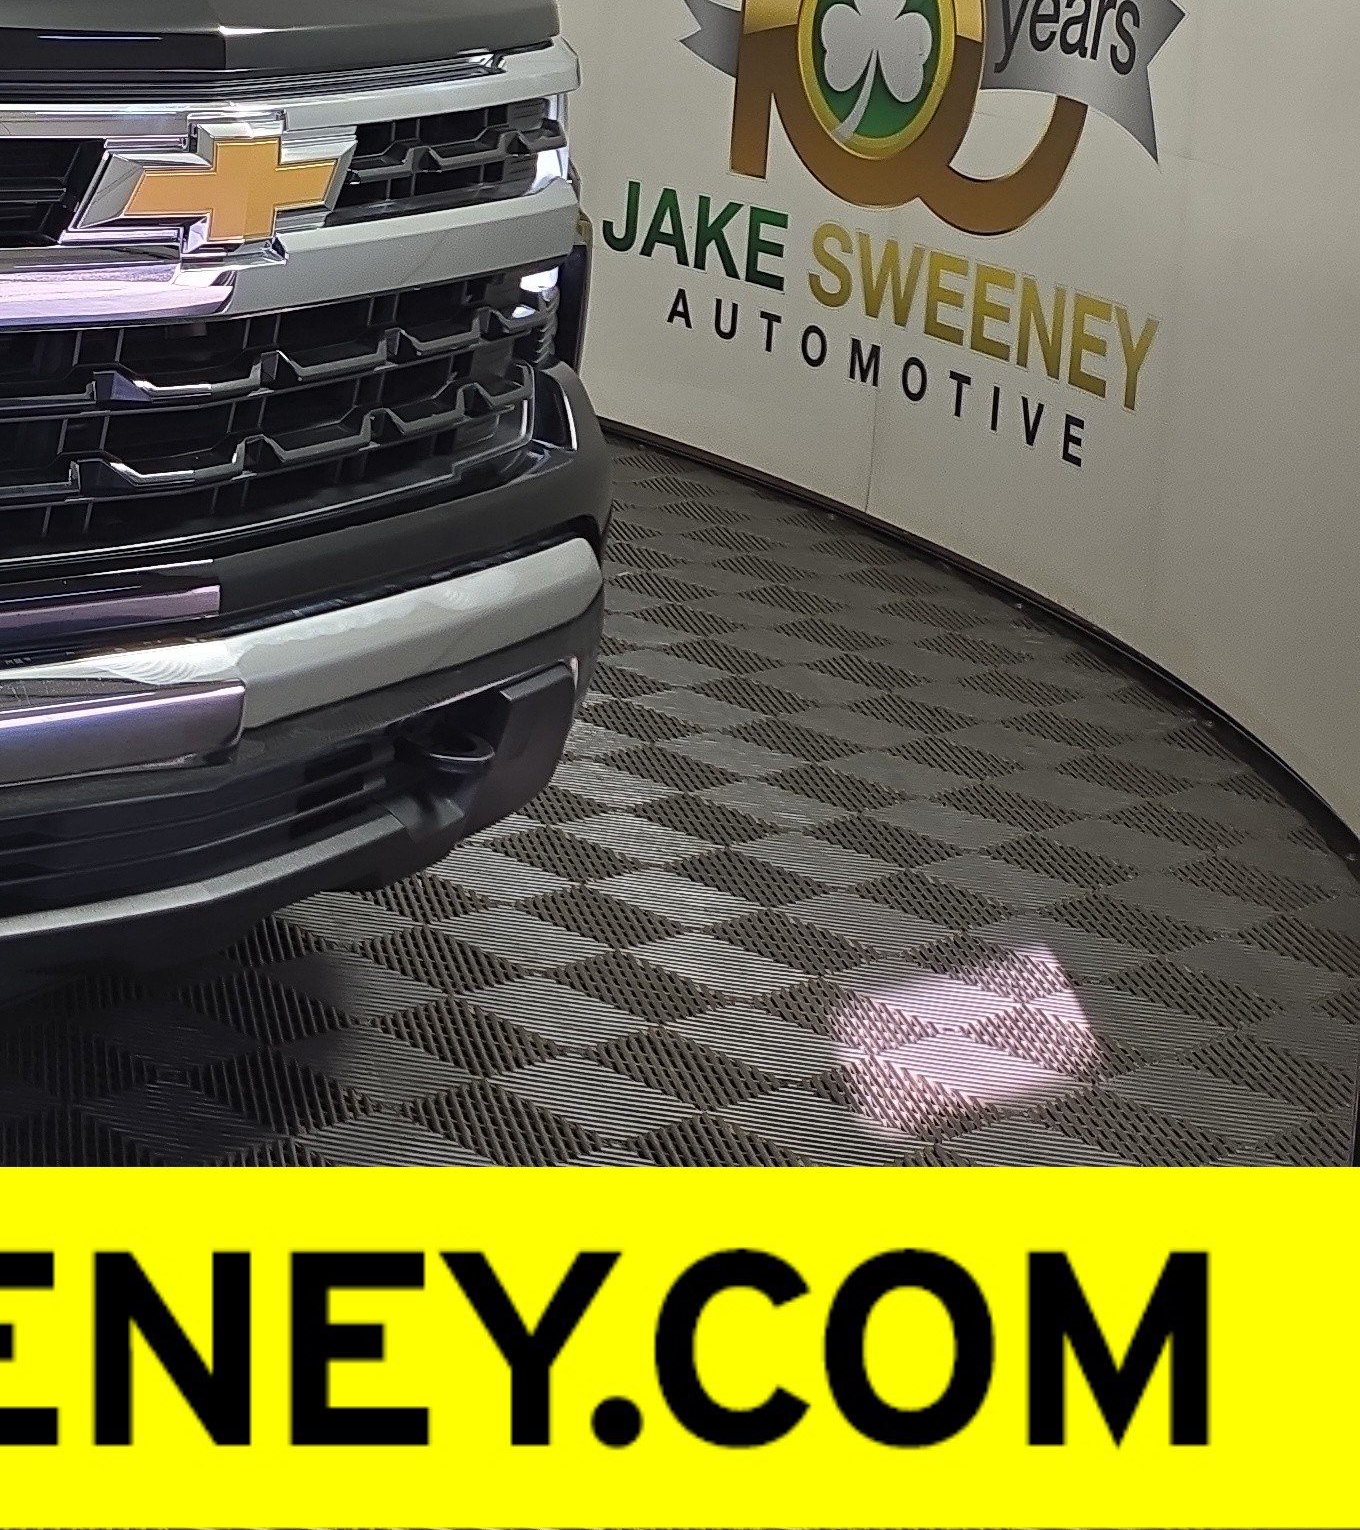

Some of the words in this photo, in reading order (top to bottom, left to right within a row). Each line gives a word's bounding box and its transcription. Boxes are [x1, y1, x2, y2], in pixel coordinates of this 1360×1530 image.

[602, 181, 788, 292] JAKE
[809, 223, 1160, 411] SWEENEY
[667, 289, 1085, 467] AUTOMOTIVE
